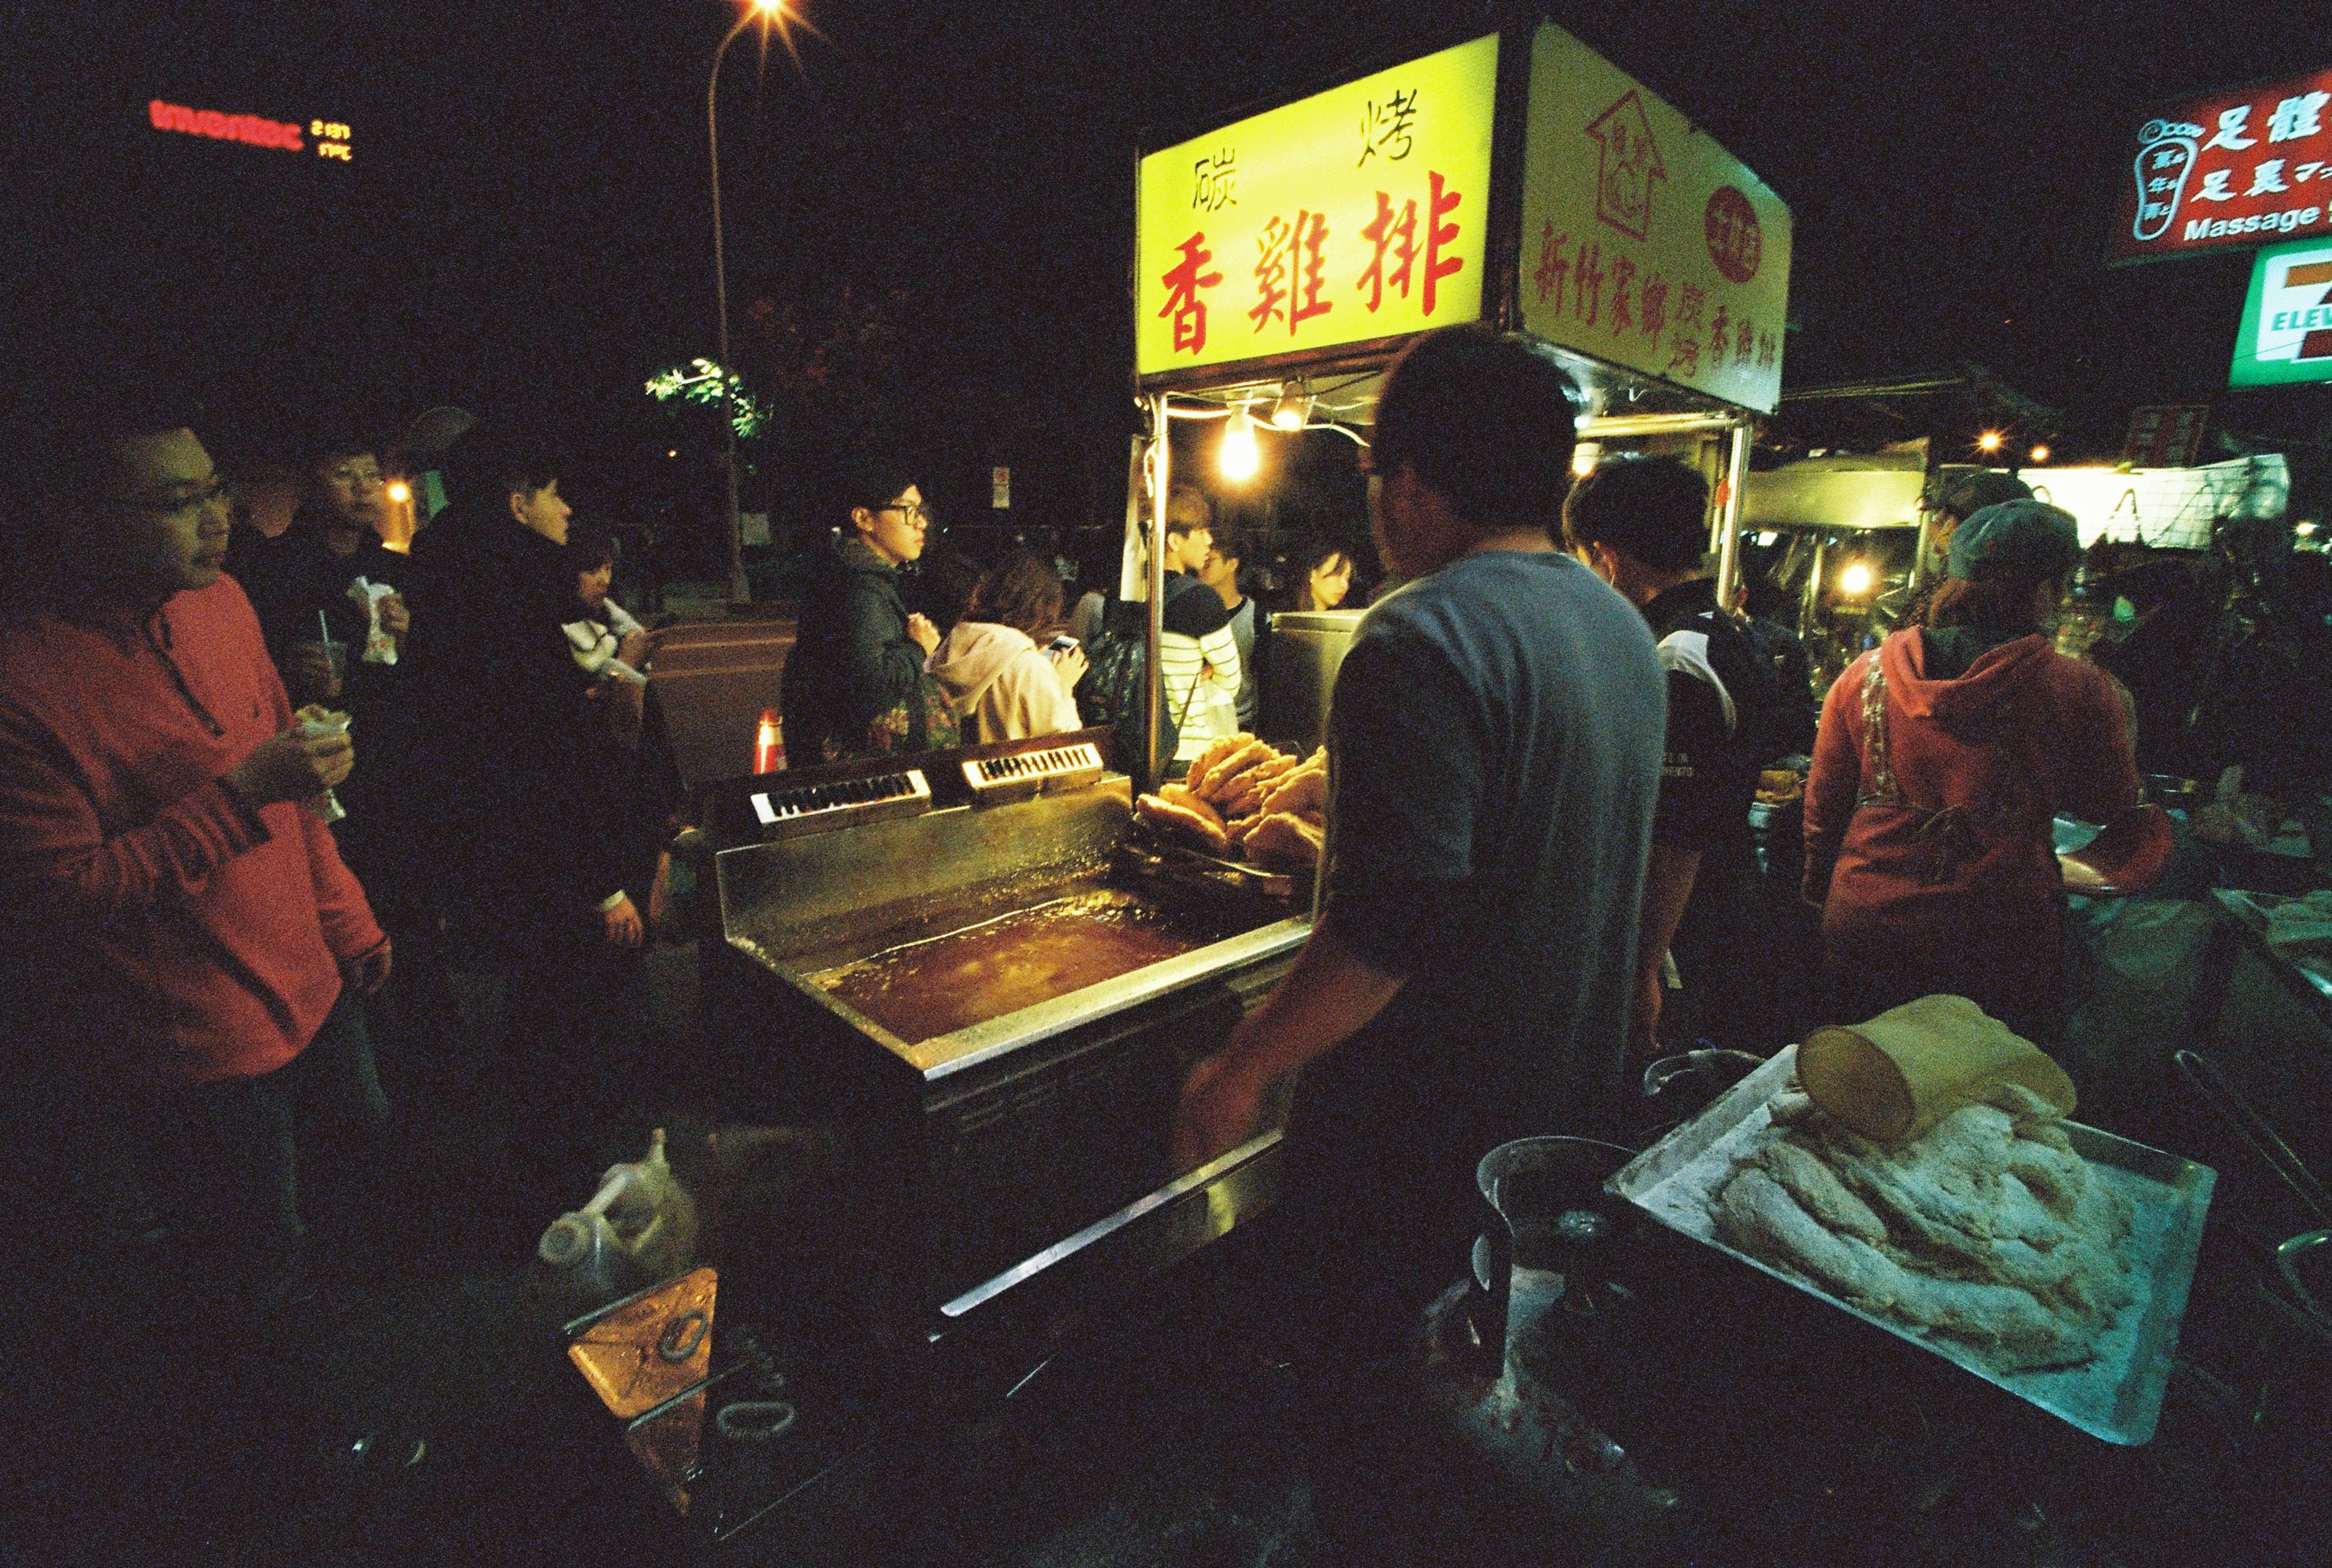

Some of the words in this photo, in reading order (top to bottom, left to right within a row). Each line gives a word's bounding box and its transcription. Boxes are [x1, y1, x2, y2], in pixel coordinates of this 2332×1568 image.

[1193, 89, 1417, 213] 碳烤
[1158, 170, 1465, 355] 香雞排
[2183, 204, 2321, 242] Massage
